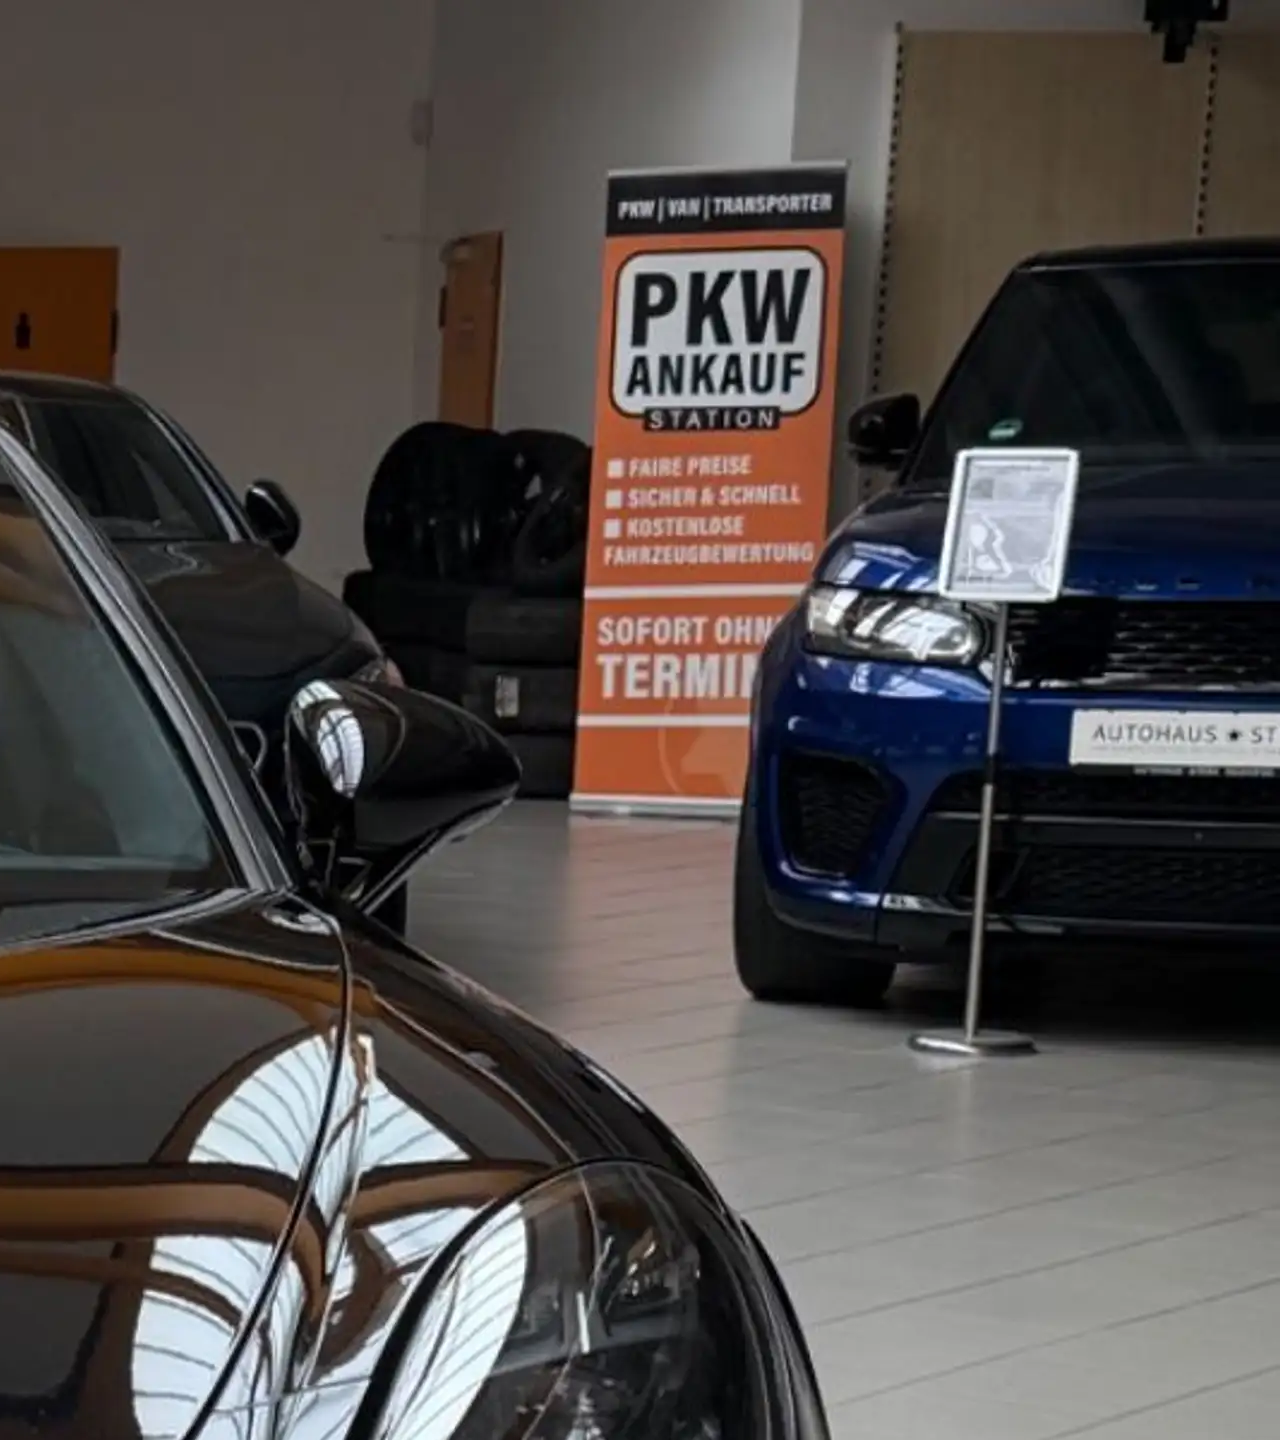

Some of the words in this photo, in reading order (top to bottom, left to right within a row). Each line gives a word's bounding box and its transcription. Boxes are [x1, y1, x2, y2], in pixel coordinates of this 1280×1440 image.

[617, 200, 655, 219] PKW
[667, 198, 702, 217] VAN
[713, 193, 833, 216] TRANSPORTER
[630, 268, 812, 347] PKW
[626, 351, 806, 396] ANKAUF
[650, 409, 774, 430] STATION
[629, 457, 683, 478] FAIRE
[687, 454, 753, 476] PREISE
[628, 487, 697, 509] SICHER
[700, 487, 715, 507] &
[720, 484, 802, 506] SCHNELL
[627, 516, 745, 538] KOSTENLOSE
[604, 541, 815, 566] FAHRZEUGBEWERTUNG
[597, 615, 709, 646] SOFORT
[714, 615, 782, 645] OHN
[1092, 723, 1218, 744] AUTOHAUS
